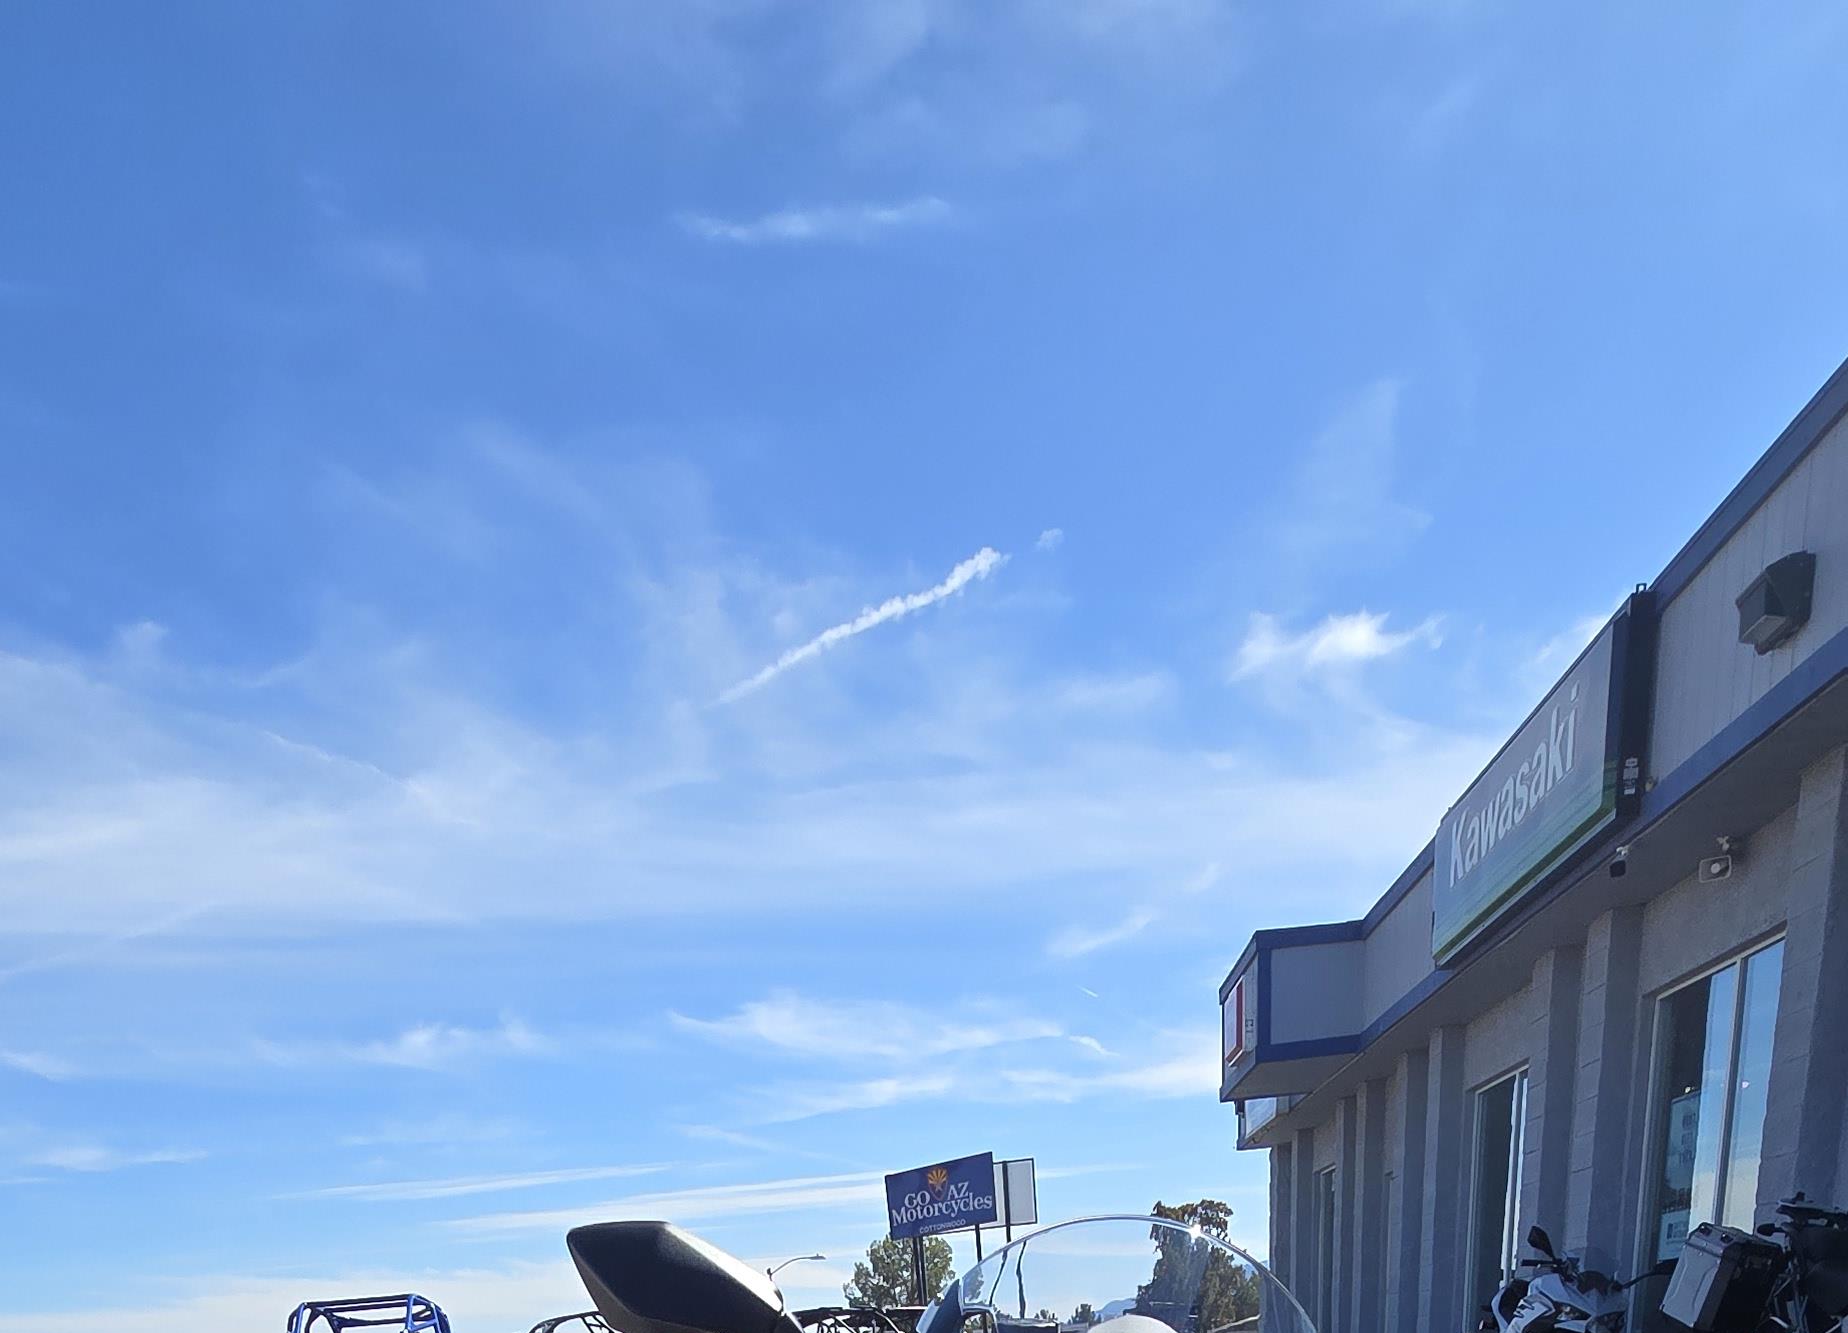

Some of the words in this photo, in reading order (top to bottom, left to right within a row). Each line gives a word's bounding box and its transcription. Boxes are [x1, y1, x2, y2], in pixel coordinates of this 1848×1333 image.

[1450, 680, 1579, 888] Kawasaki
[892, 1192, 993, 1226] Motorcycles
[904, 1190, 931, 1208] GO
[947, 1181, 969, 1200] AZ
[919, 1218, 966, 1234] COTTONWOOD
